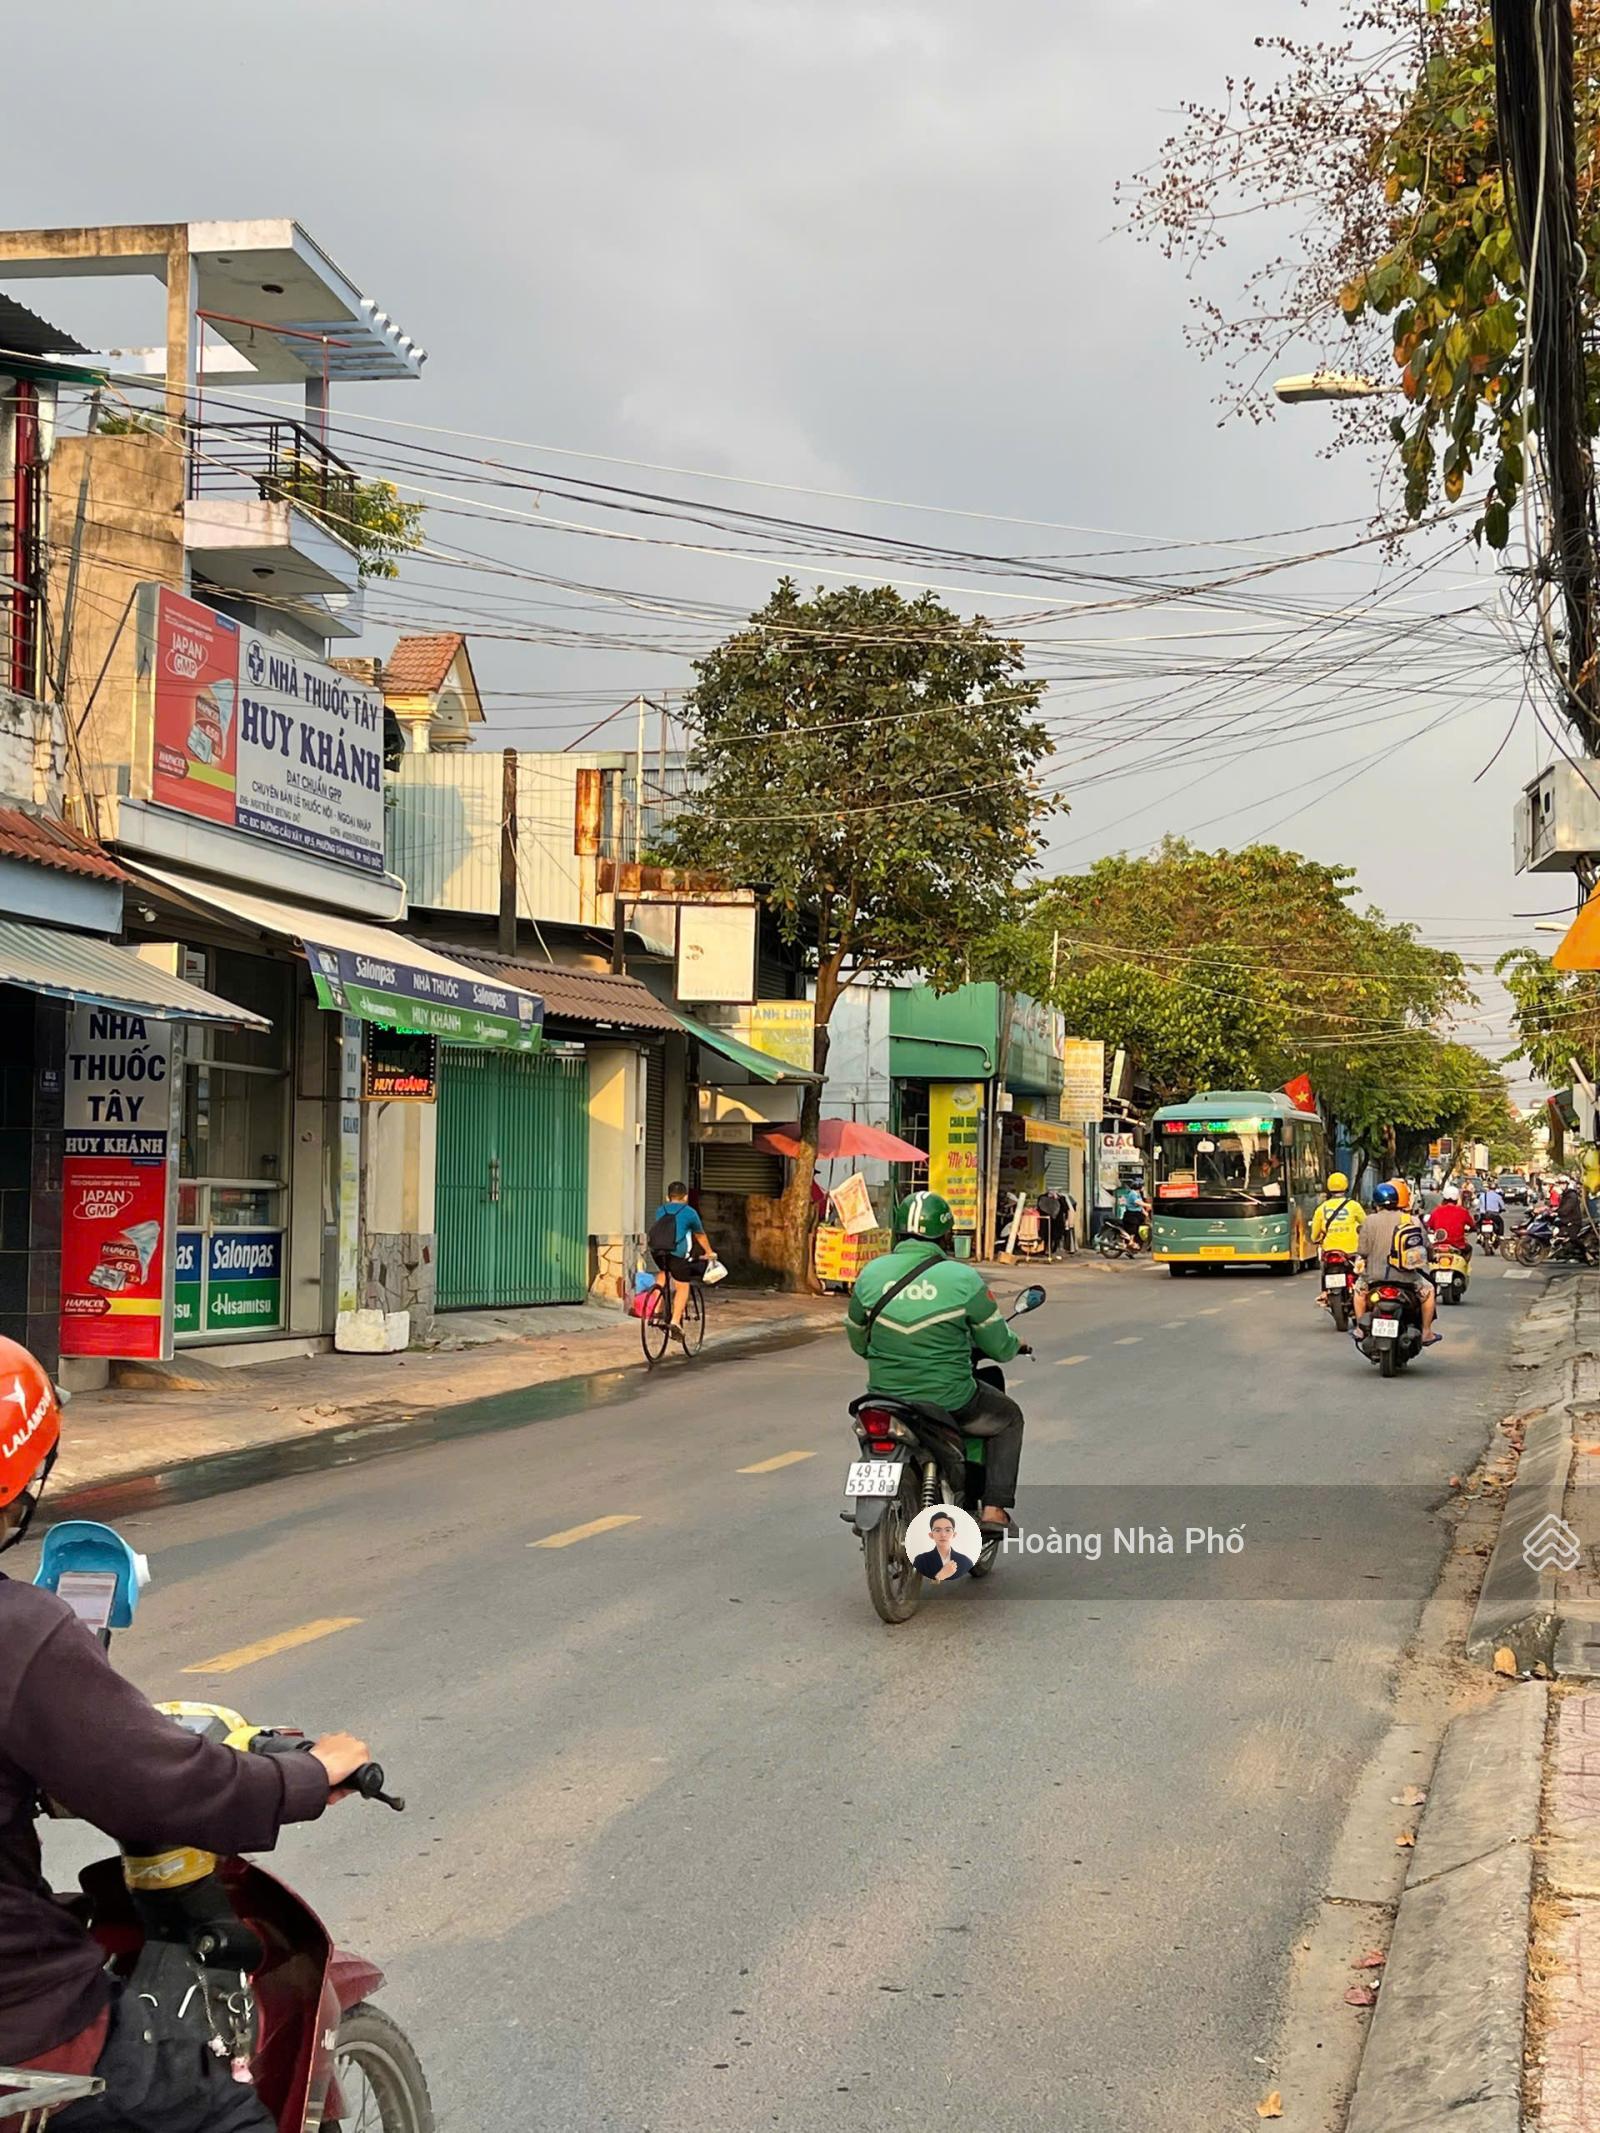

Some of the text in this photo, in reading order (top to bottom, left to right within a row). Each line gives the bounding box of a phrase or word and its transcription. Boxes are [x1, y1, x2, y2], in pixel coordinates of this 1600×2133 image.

[269, 656, 378, 732] NHÀ THUỐC TÂY
[241, 698, 381, 792] HUY KHÁNH
[356, 956, 396, 987] Salonpas
[413, 973, 431, 993] NHÀ
[472, 984, 507, 1010] Salonpas
[411, 1006, 429, 1025] HUY
[69, 1044, 166, 1081] THUỐC
[373, 1074, 429, 1092] HUY KHÁNH
[88, 1088, 145, 1122] TÂY
[65, 1134, 163, 1154] HUY KHÁNH
[80, 1190, 125, 1206] JAPAN
[86, 1204, 117, 1217] GMP
[176, 1239, 274, 1275] as Salonpas
[115, 1261, 136, 1273] 650
[65, 1298, 105, 1308] HAPACOL
[211, 1292, 272, 1316] Hisamitsu
[856, 1464, 893, 1478] 49-E1
[848, 1479, 896, 1493] 55383
